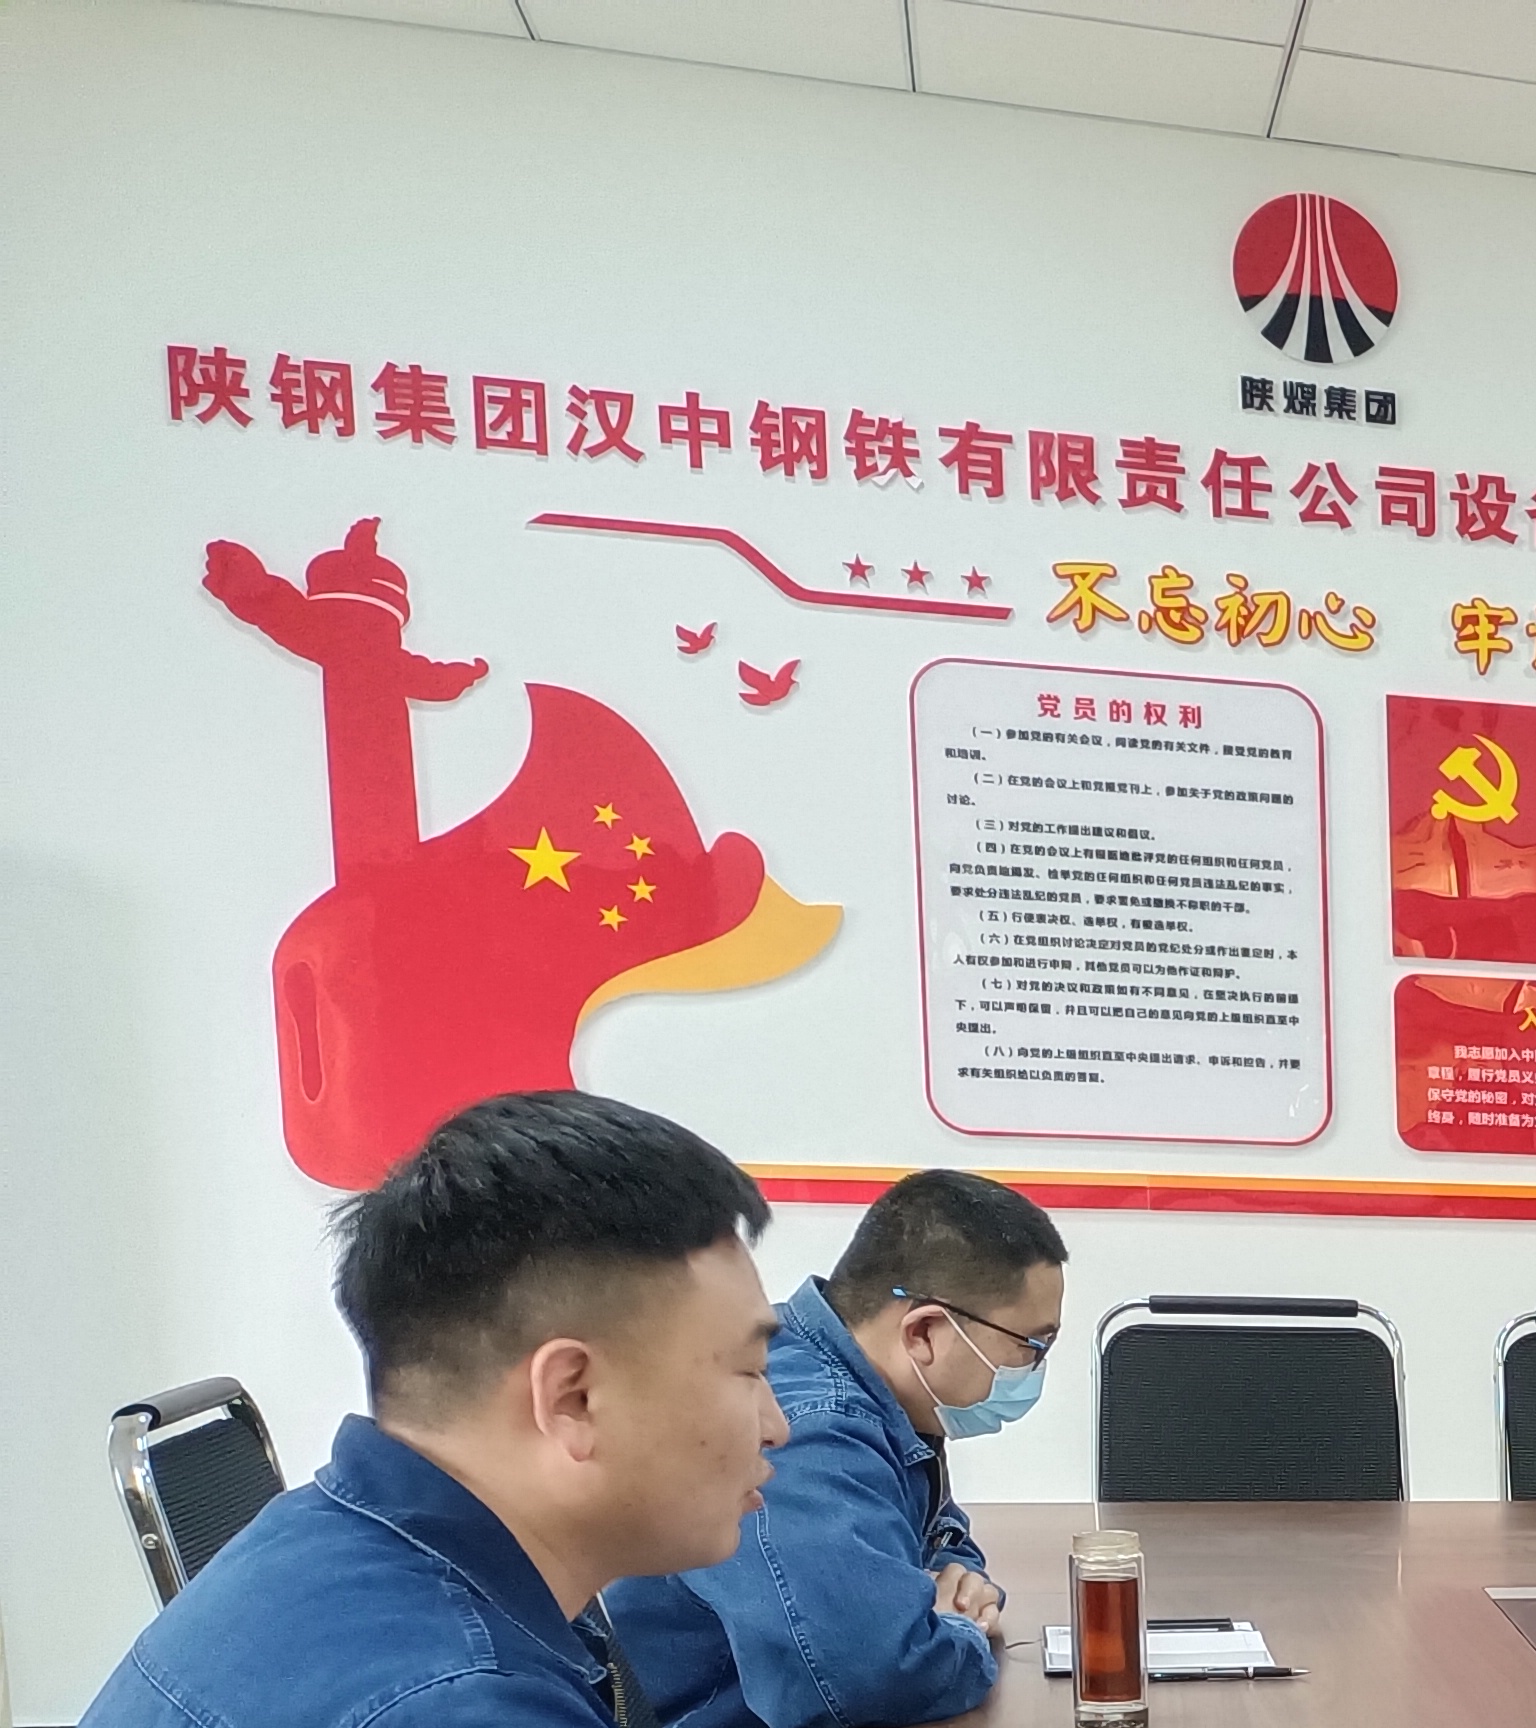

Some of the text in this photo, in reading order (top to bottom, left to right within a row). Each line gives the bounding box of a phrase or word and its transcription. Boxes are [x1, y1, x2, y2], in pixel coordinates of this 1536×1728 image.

[1240, 375, 1396, 426] 陕煤集团
[1048, 562, 1376, 652] 不忘初心
[1037, 694, 1202, 728] 党员的权利
